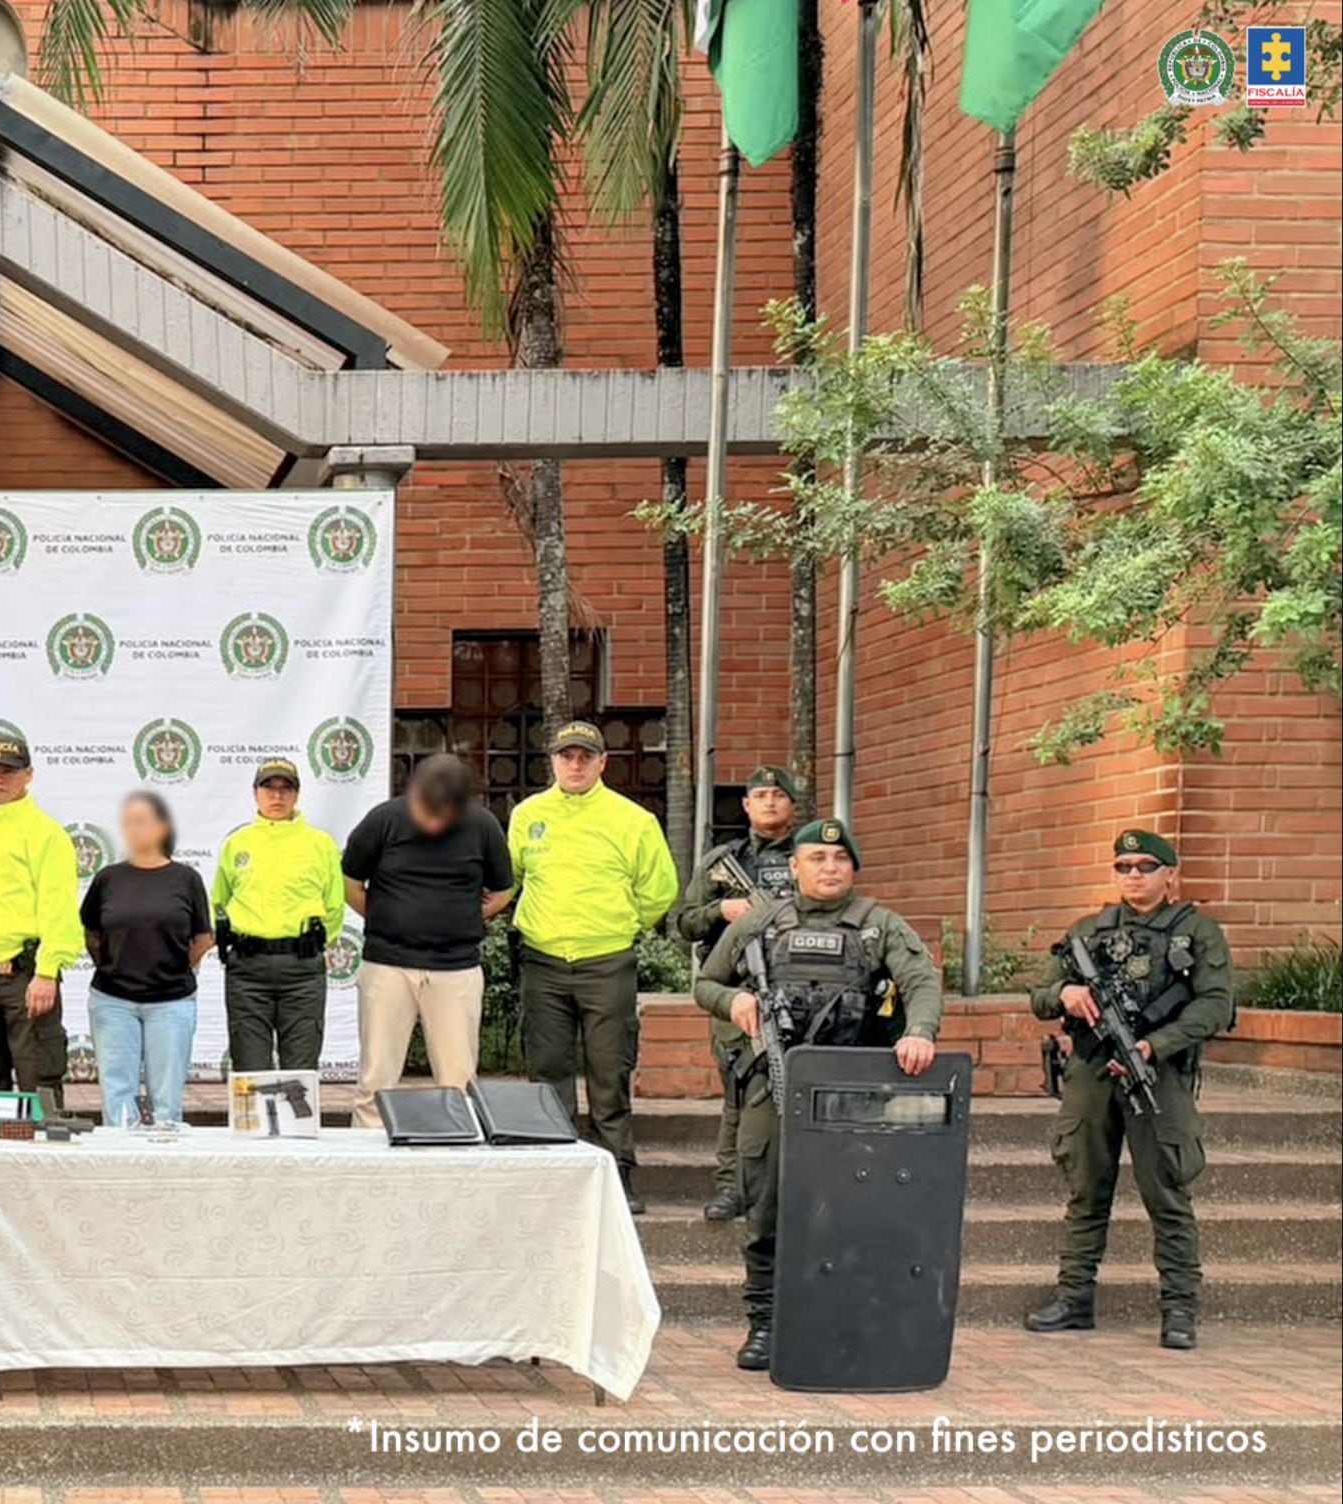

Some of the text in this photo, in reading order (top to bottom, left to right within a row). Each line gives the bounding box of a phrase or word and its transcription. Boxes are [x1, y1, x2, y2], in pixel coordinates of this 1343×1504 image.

[33, 533, 71, 542] POLICÍA
[207, 533, 246, 542] POLICÍA
[45, 545, 113, 554] DE COLOMBIA
[220, 545, 288, 553] DE COLOMBIA
[119, 639, 212, 648] POLICÍA NACIONAL
[294, 639, 386, 648] POLICÍA NACIONAL
[133, 651, 200, 659] DE COLOMBIA
[322, 649, 373, 658] COLOMBIA
[35, 745, 126, 754] POLICÍA NACIONAL
[207, 745, 298, 754] POLICÍA NACIONAL
[47, 756, 114, 765] DE COLOMBIA
[220, 756, 232, 764] DE
[174, 848, 213, 857] CIONAL
[794, 936, 837, 949] GOES
